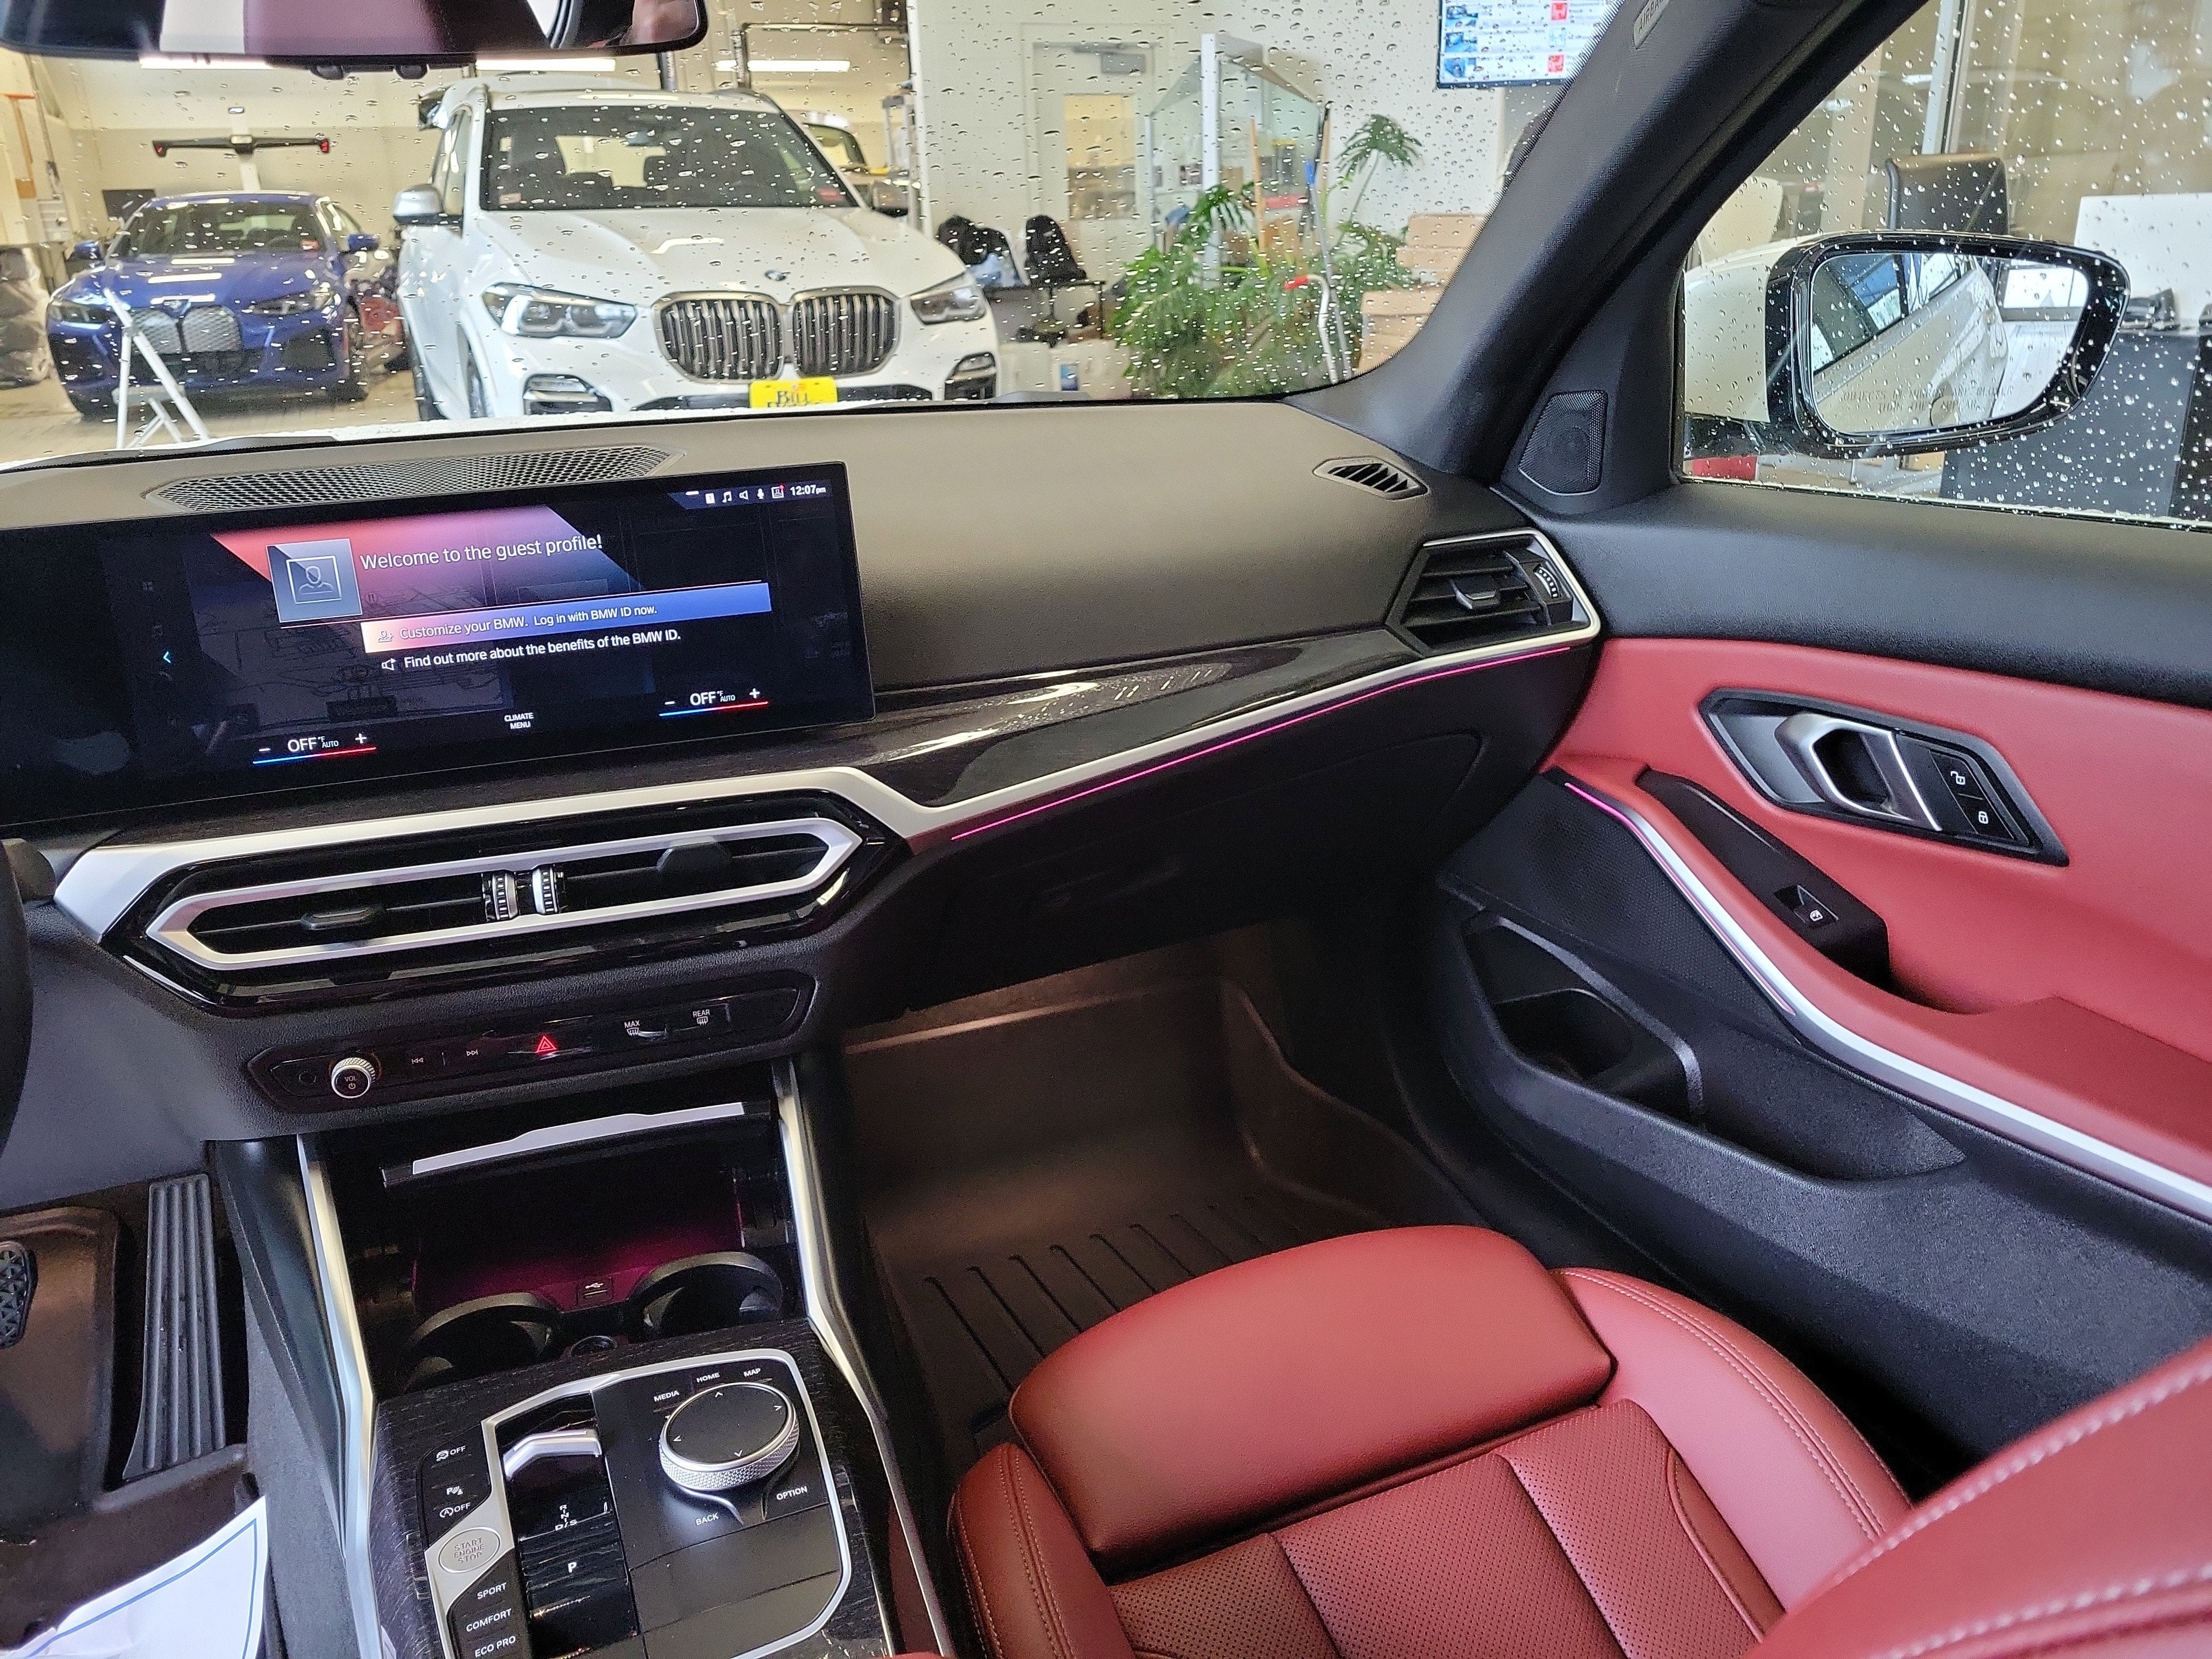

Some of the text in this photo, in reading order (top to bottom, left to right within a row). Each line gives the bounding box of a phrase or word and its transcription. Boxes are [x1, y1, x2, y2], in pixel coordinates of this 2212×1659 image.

[1638, 0, 1663, 34] AIRBA
[790, 484, 826, 496] 12:07pm
[360, 534, 602, 569] Welcome to the guest profile!
[399, 606, 657, 639] Customize your BMW. Log in with BMW ID now.
[404, 629, 681, 668] Find out more about the benefits of the BMW ID.
[690, 691, 716, 706] OFF
[504, 712, 534, 721] CLIMATE
[510, 720, 531, 730] MENU
[287, 737, 317, 752] OFF
[692, 1009, 710, 1018] REAR
[624, 1020, 640, 1029] MAX
[696, 1372, 720, 1383] HOME
[743, 1368, 761, 1377] MAP
[653, 1390, 680, 1402] MEDIA
[450, 1446, 466, 1455] OFF
[776, 1486, 808, 1500] OPTION
[454, 1502, 471, 1513] OFF
[695, 1512, 719, 1525] BACK
[455, 1537, 482, 1551] START
[454, 1544, 484, 1558] ENGINE
[458, 1551, 482, 1563] STOP
[568, 1562, 577, 1573] P
[477, 1582, 507, 1600] SPORT
[466, 1608, 512, 1632] COMFORT
[475, 1635, 516, 1658] ECO PRO
